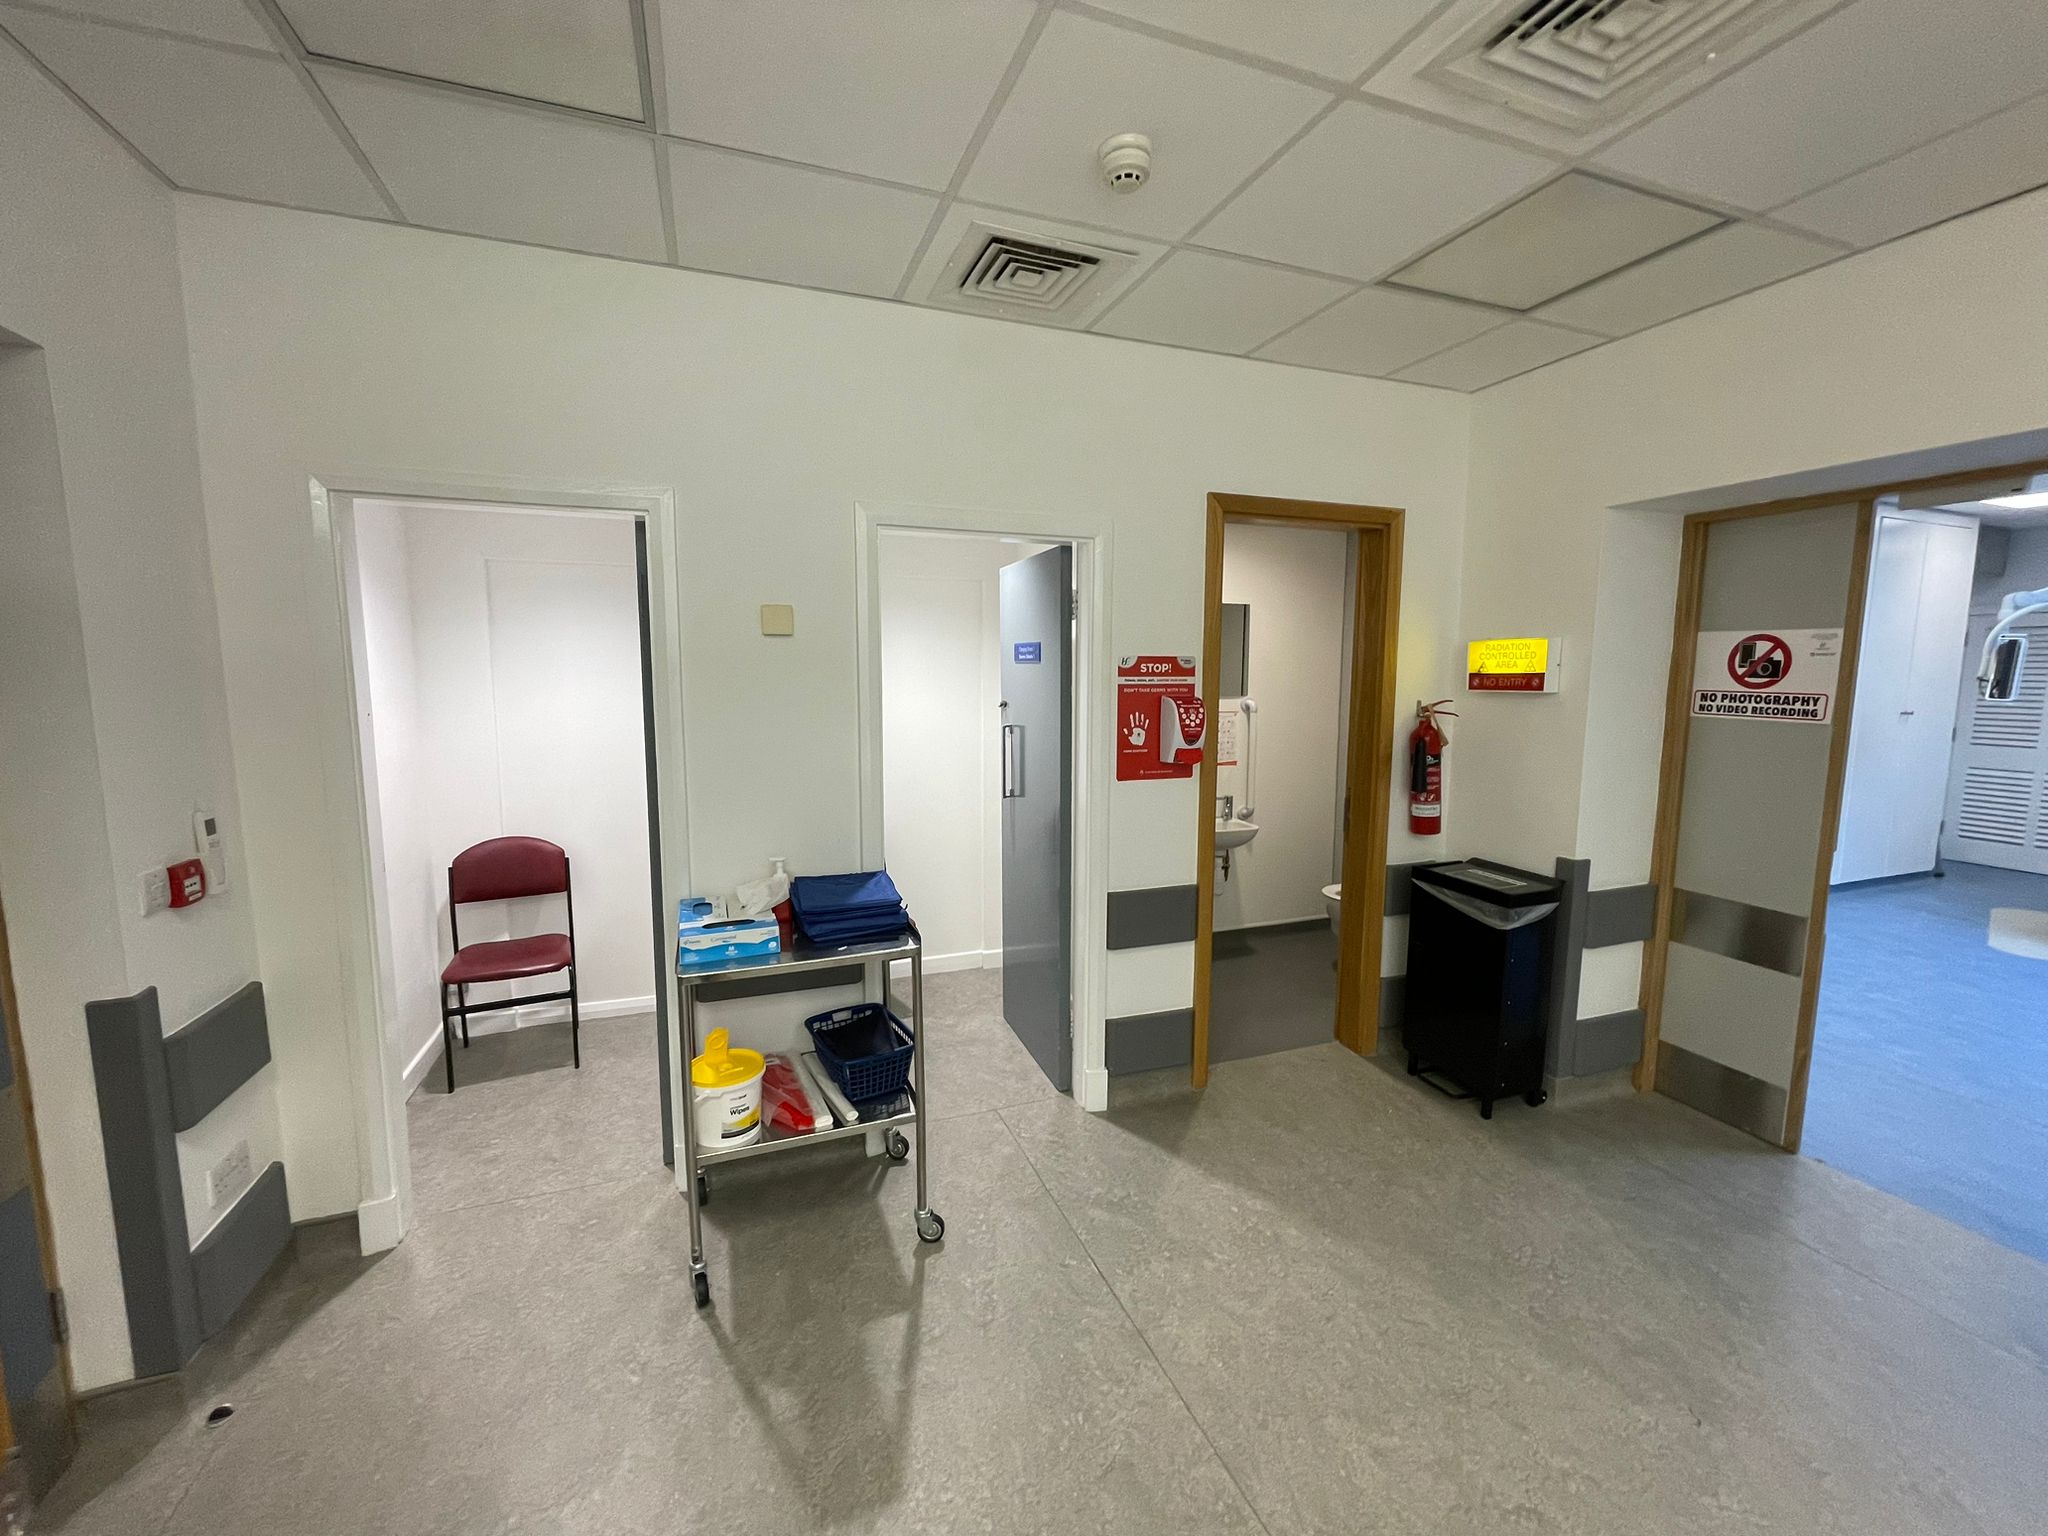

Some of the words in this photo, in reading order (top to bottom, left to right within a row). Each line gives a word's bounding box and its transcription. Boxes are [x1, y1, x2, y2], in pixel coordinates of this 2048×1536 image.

[1486, 643, 1531, 651] RADIATION
[1479, 651, 1537, 660] CONTROLLED
[1140, 663, 1172, 673] STOP!
[1483, 678, 1496, 686] NO
[1499, 678, 1527, 686] ENTRY
[1700, 693, 1718, 703] NO
[1720, 693, 1821, 707] PHOTOGRAPHY
[1698, 704, 1713, 712] NO
[1716, 704, 1748, 714] VIDEO
[1750, 705, 1818, 718] RECORDING
[729, 1105, 750, 1116] Wipes
